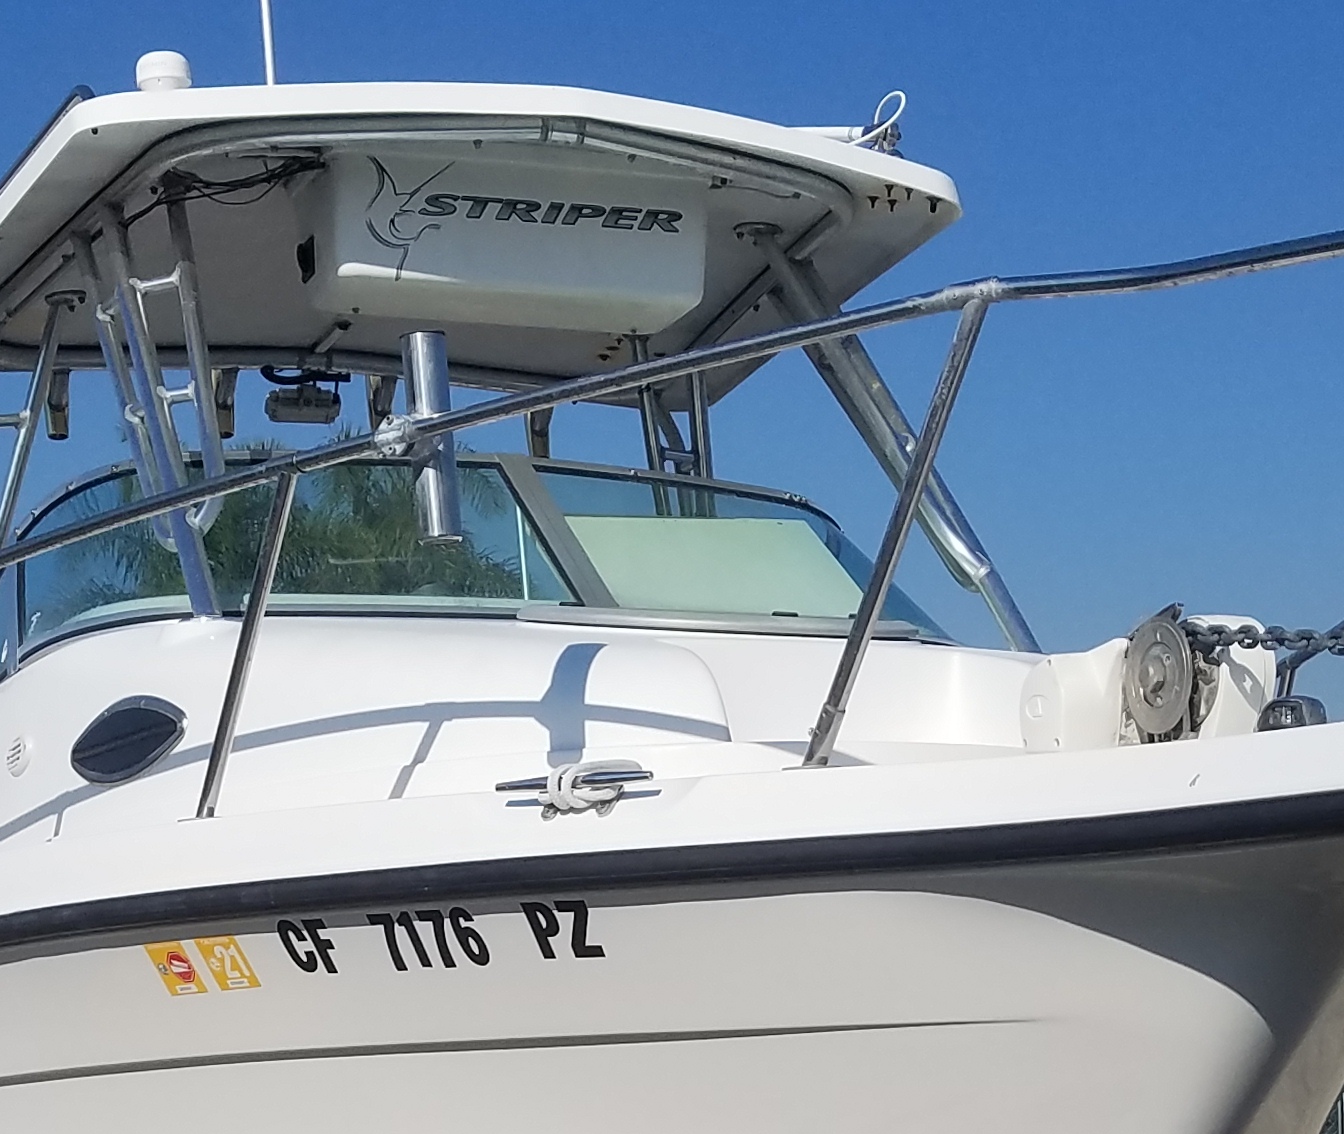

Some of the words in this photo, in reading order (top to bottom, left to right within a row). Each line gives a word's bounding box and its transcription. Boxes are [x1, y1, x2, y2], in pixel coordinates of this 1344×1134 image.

[417, 192, 684, 234] STRIPER
[276, 917, 340, 975] CF
[365, 906, 492, 973] 7176
[519, 899, 607, 961] PZ
[213, 944, 251, 978] 21
